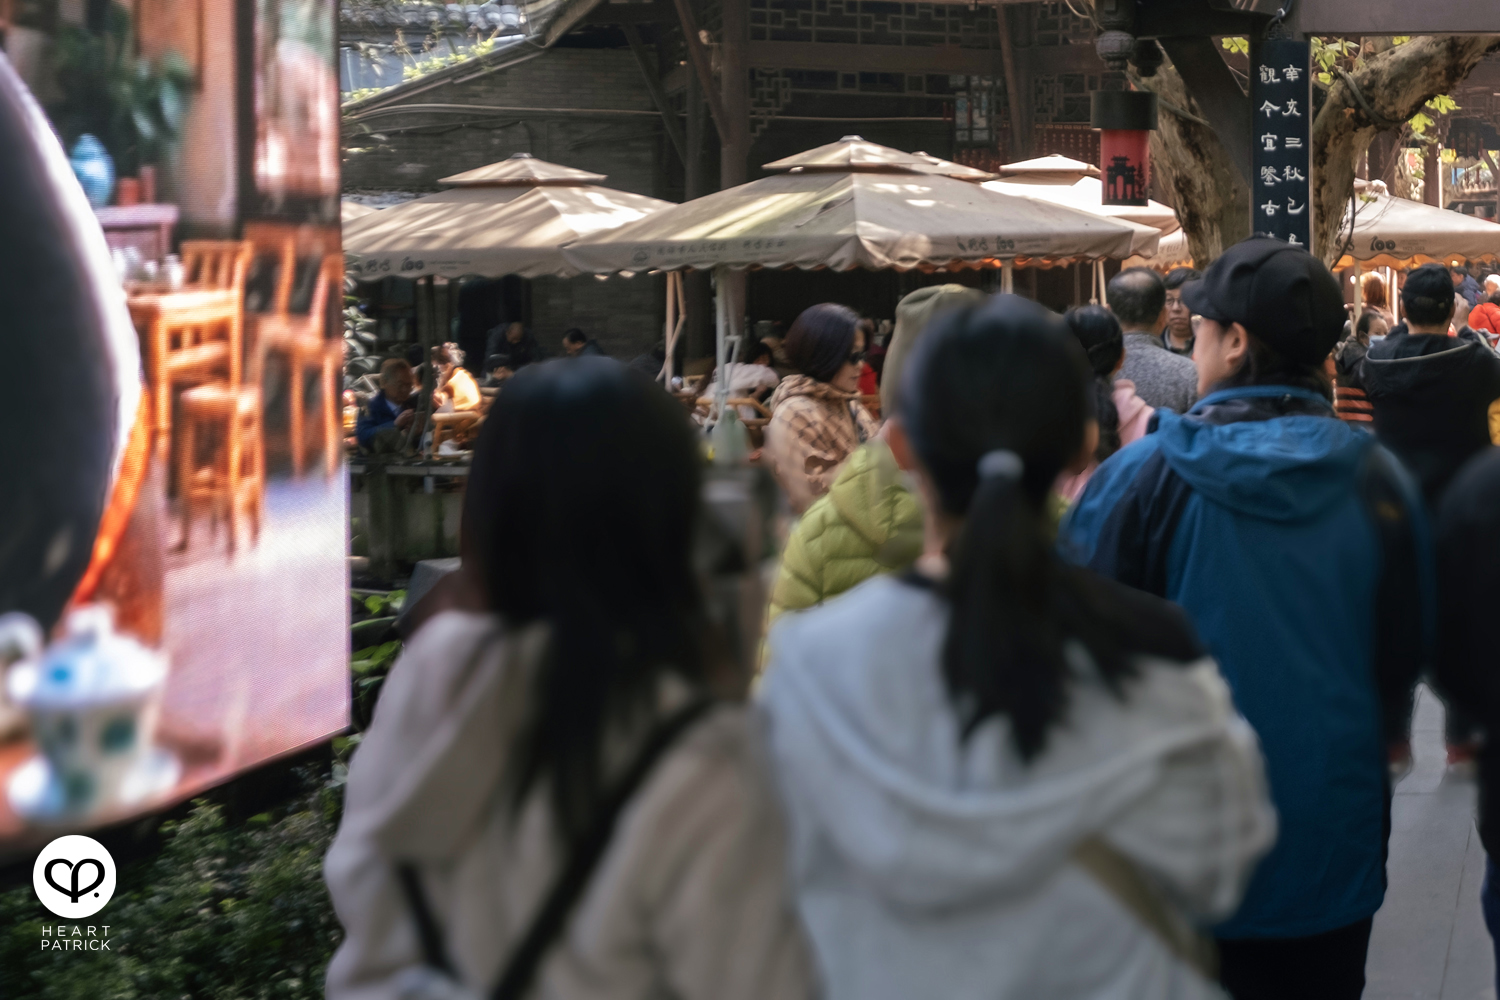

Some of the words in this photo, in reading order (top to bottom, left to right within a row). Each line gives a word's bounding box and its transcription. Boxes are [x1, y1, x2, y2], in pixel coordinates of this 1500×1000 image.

[1259, 64, 1282, 239] 觀今宜鑒古
